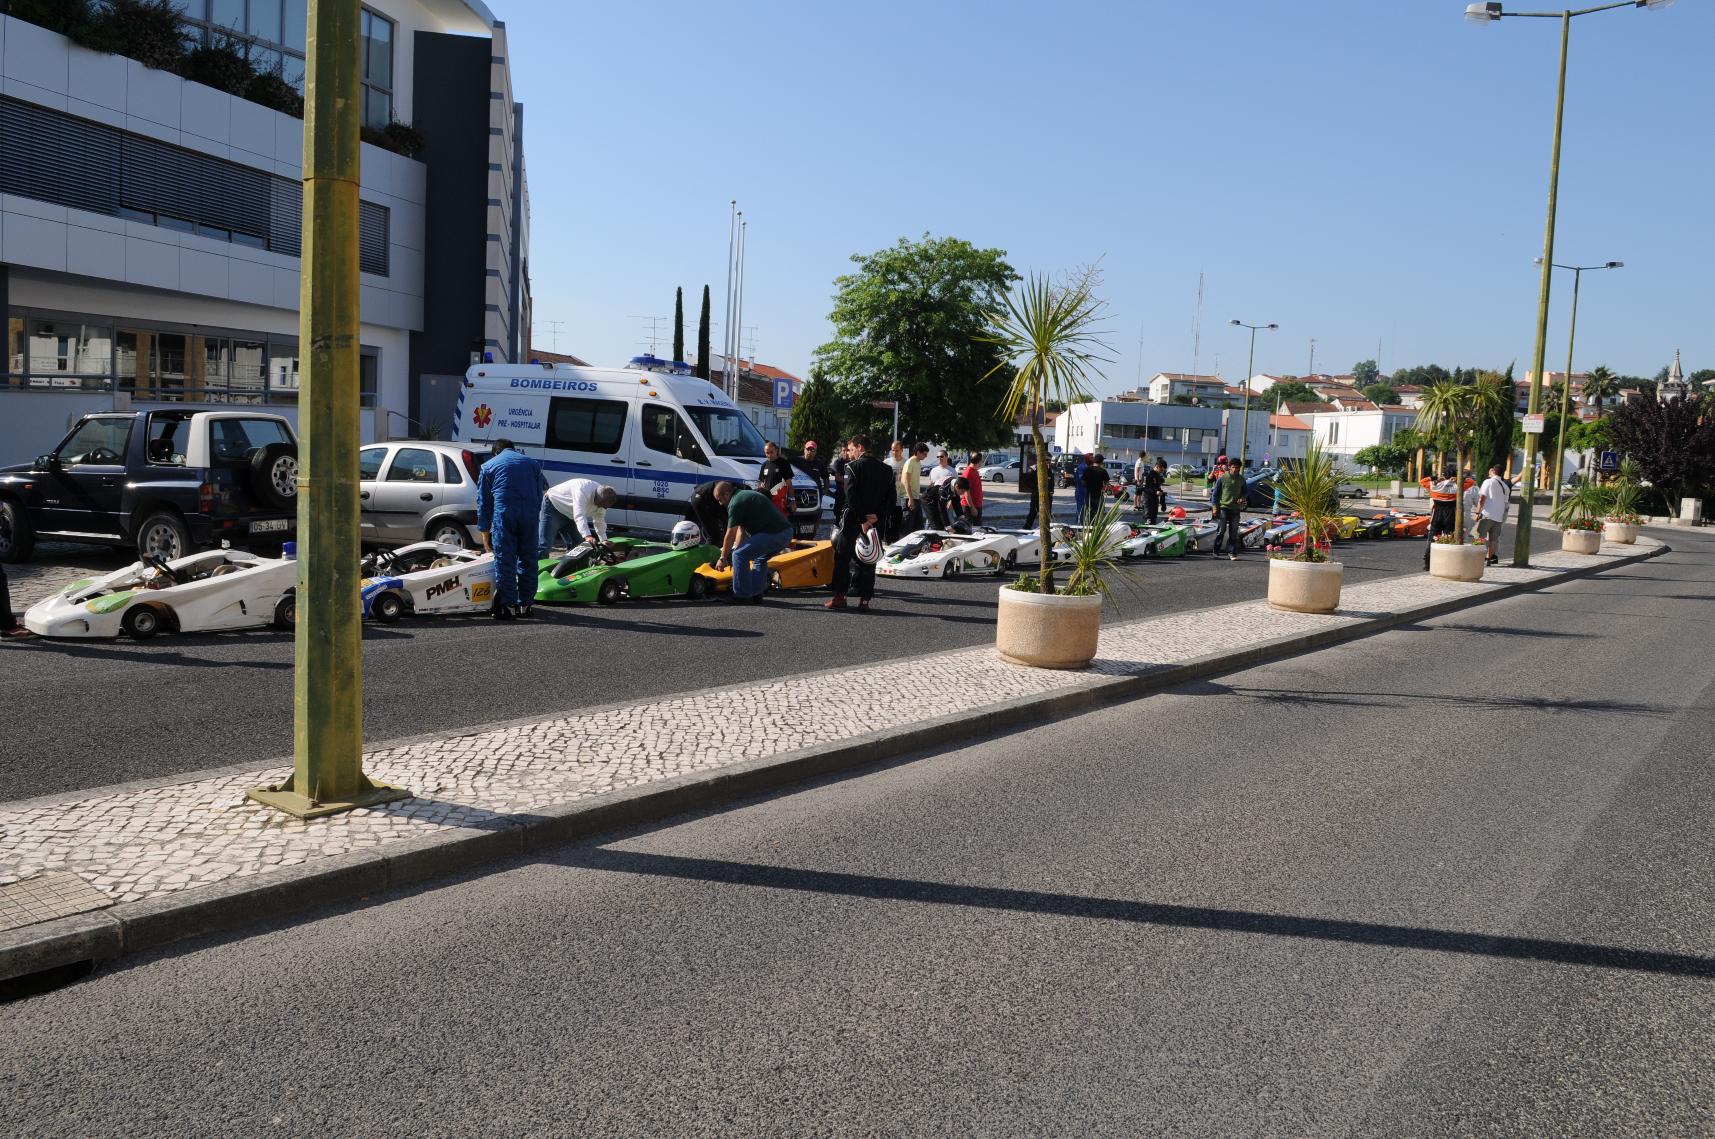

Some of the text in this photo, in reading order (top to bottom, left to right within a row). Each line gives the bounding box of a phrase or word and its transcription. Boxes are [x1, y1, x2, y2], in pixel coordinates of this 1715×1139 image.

[510, 378, 598, 391] BOMBEIROS
[777, 381, 790, 405] P
[425, 575, 460, 600] PMH
